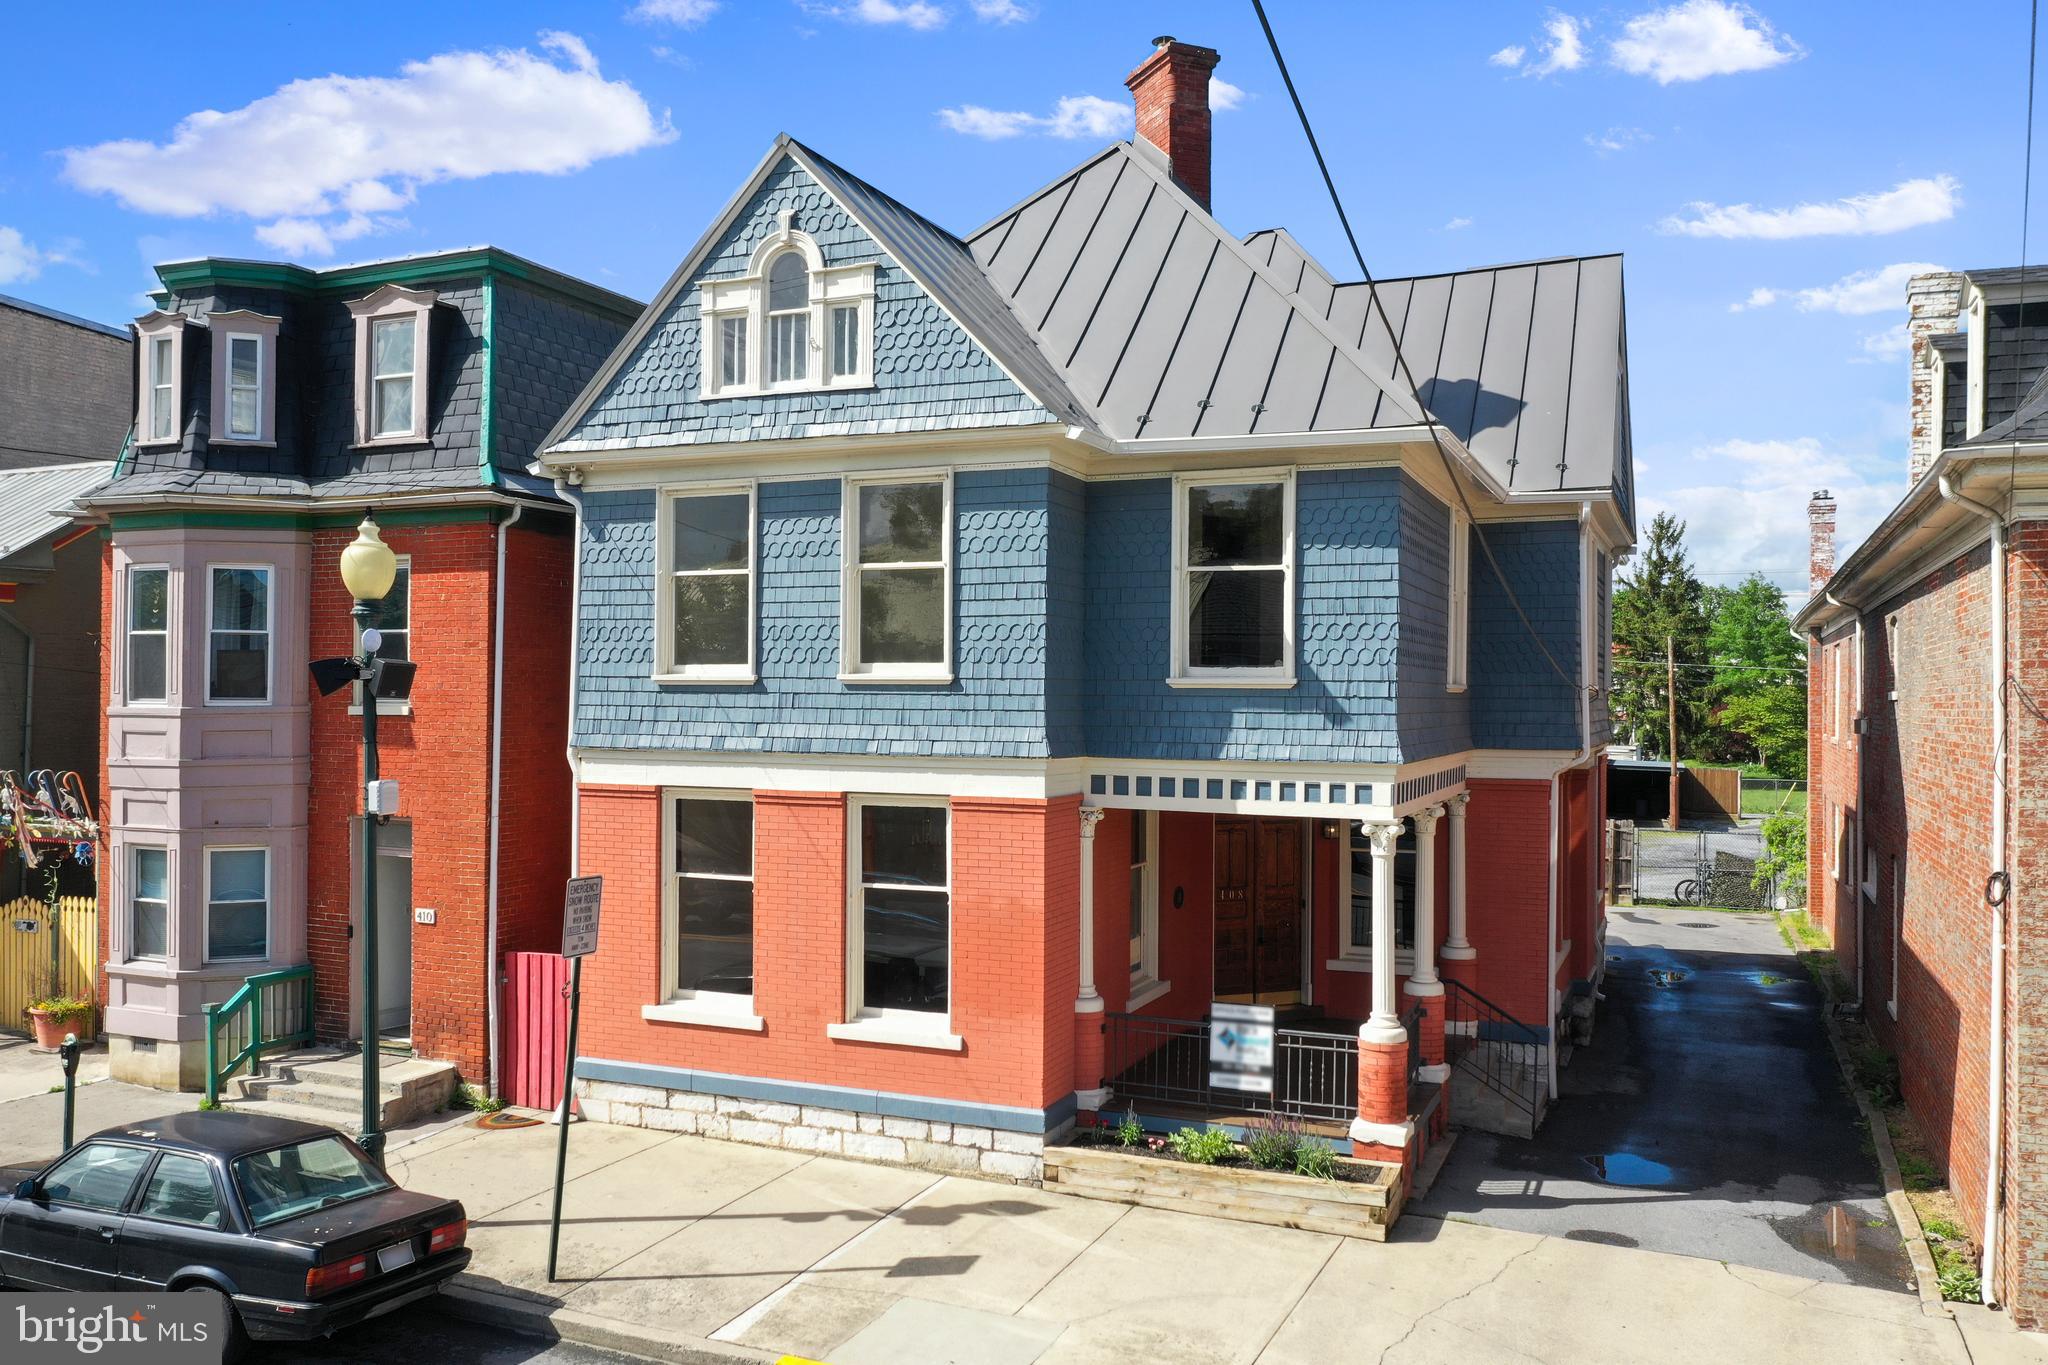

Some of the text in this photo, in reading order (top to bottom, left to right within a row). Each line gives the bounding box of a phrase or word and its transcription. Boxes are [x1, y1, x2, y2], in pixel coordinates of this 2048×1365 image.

[570, 883, 599, 895] EMERGENCY
[569, 894, 599, 906] SNOW ROUTE
[417, 911, 432, 922] 410
